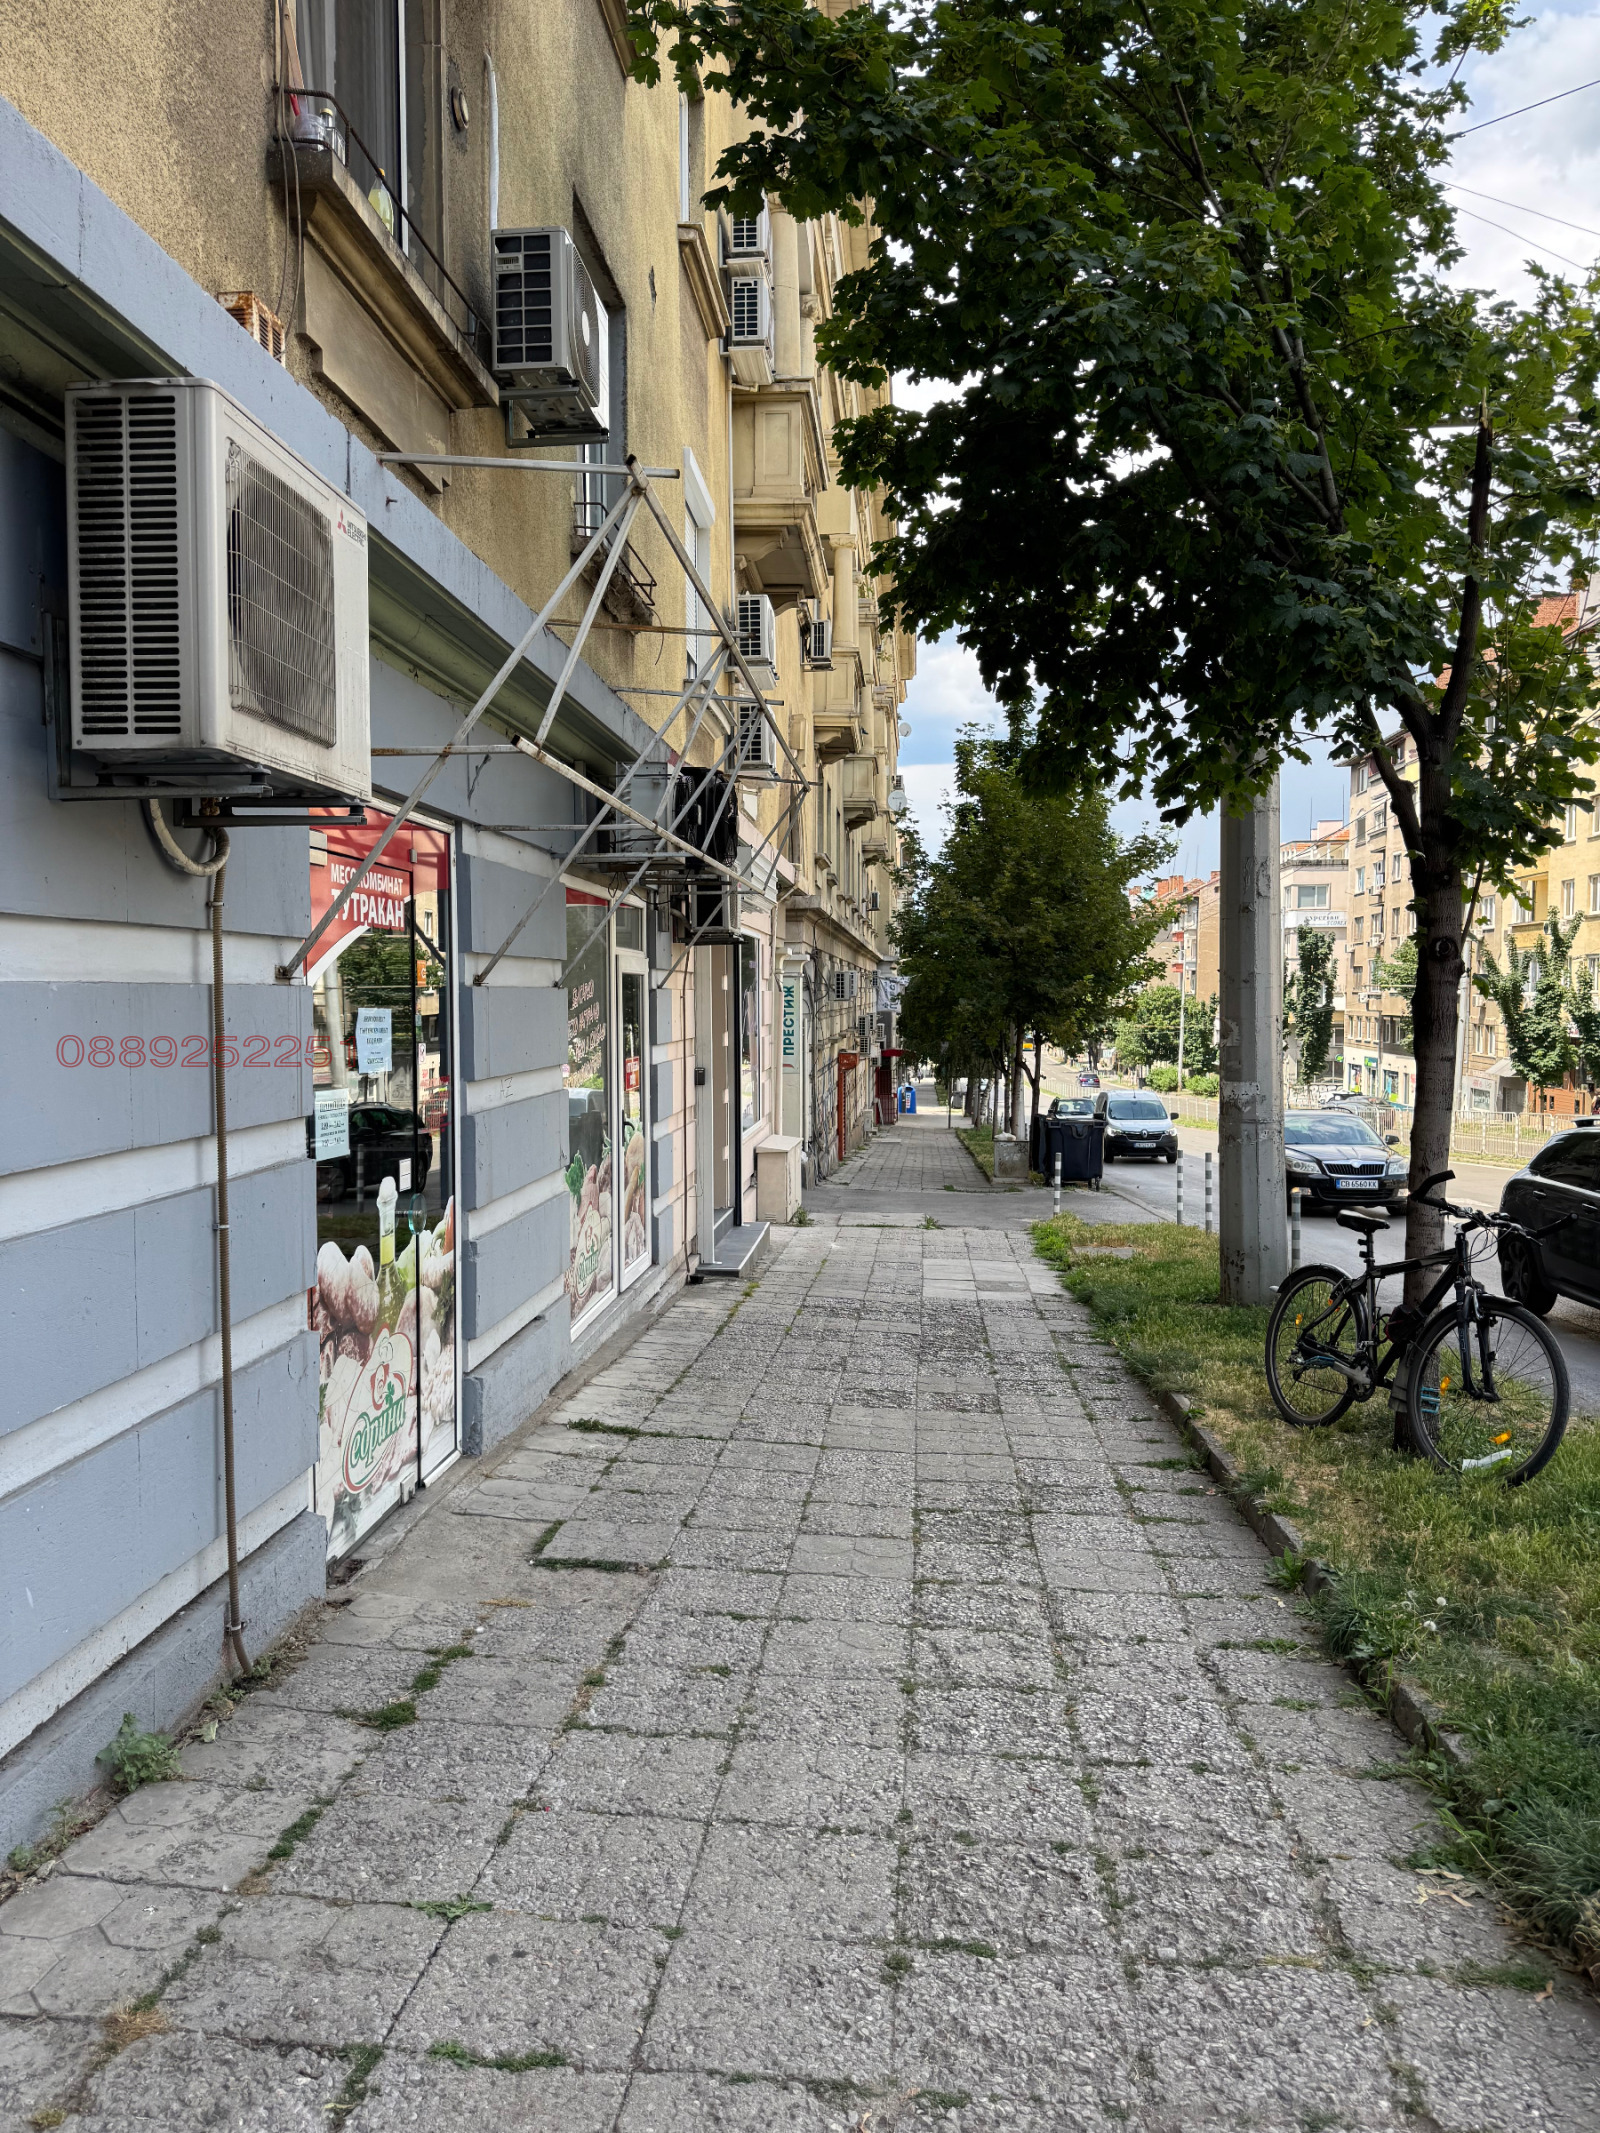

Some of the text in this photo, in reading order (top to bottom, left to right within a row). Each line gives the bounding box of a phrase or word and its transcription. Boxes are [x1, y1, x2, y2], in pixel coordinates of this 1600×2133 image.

[783, 984, 795, 1056] ПРЕСТИЖ
[1341, 1180, 1350, 1188] CB
[1351, 1180, 1368, 1188] 6560
